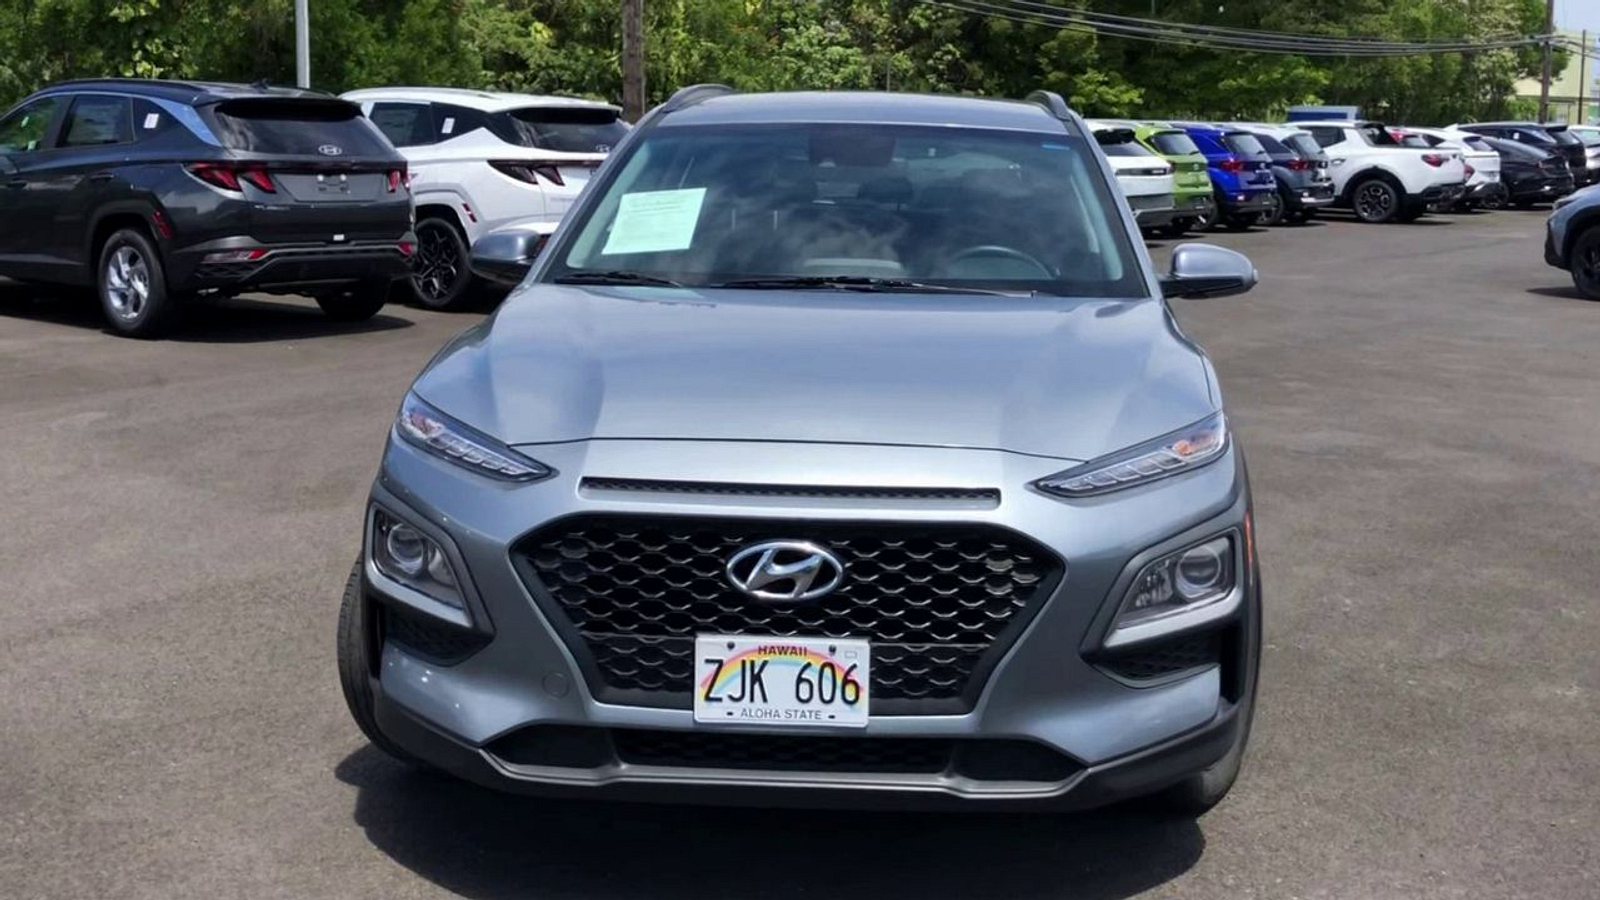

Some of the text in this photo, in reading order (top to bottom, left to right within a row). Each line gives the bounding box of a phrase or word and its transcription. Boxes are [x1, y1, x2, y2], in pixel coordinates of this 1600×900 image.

[757, 645, 808, 657] HAWAII
[704, 658, 860, 705] ZJK 606
[740, 708, 822, 720] ALOHA STATE
